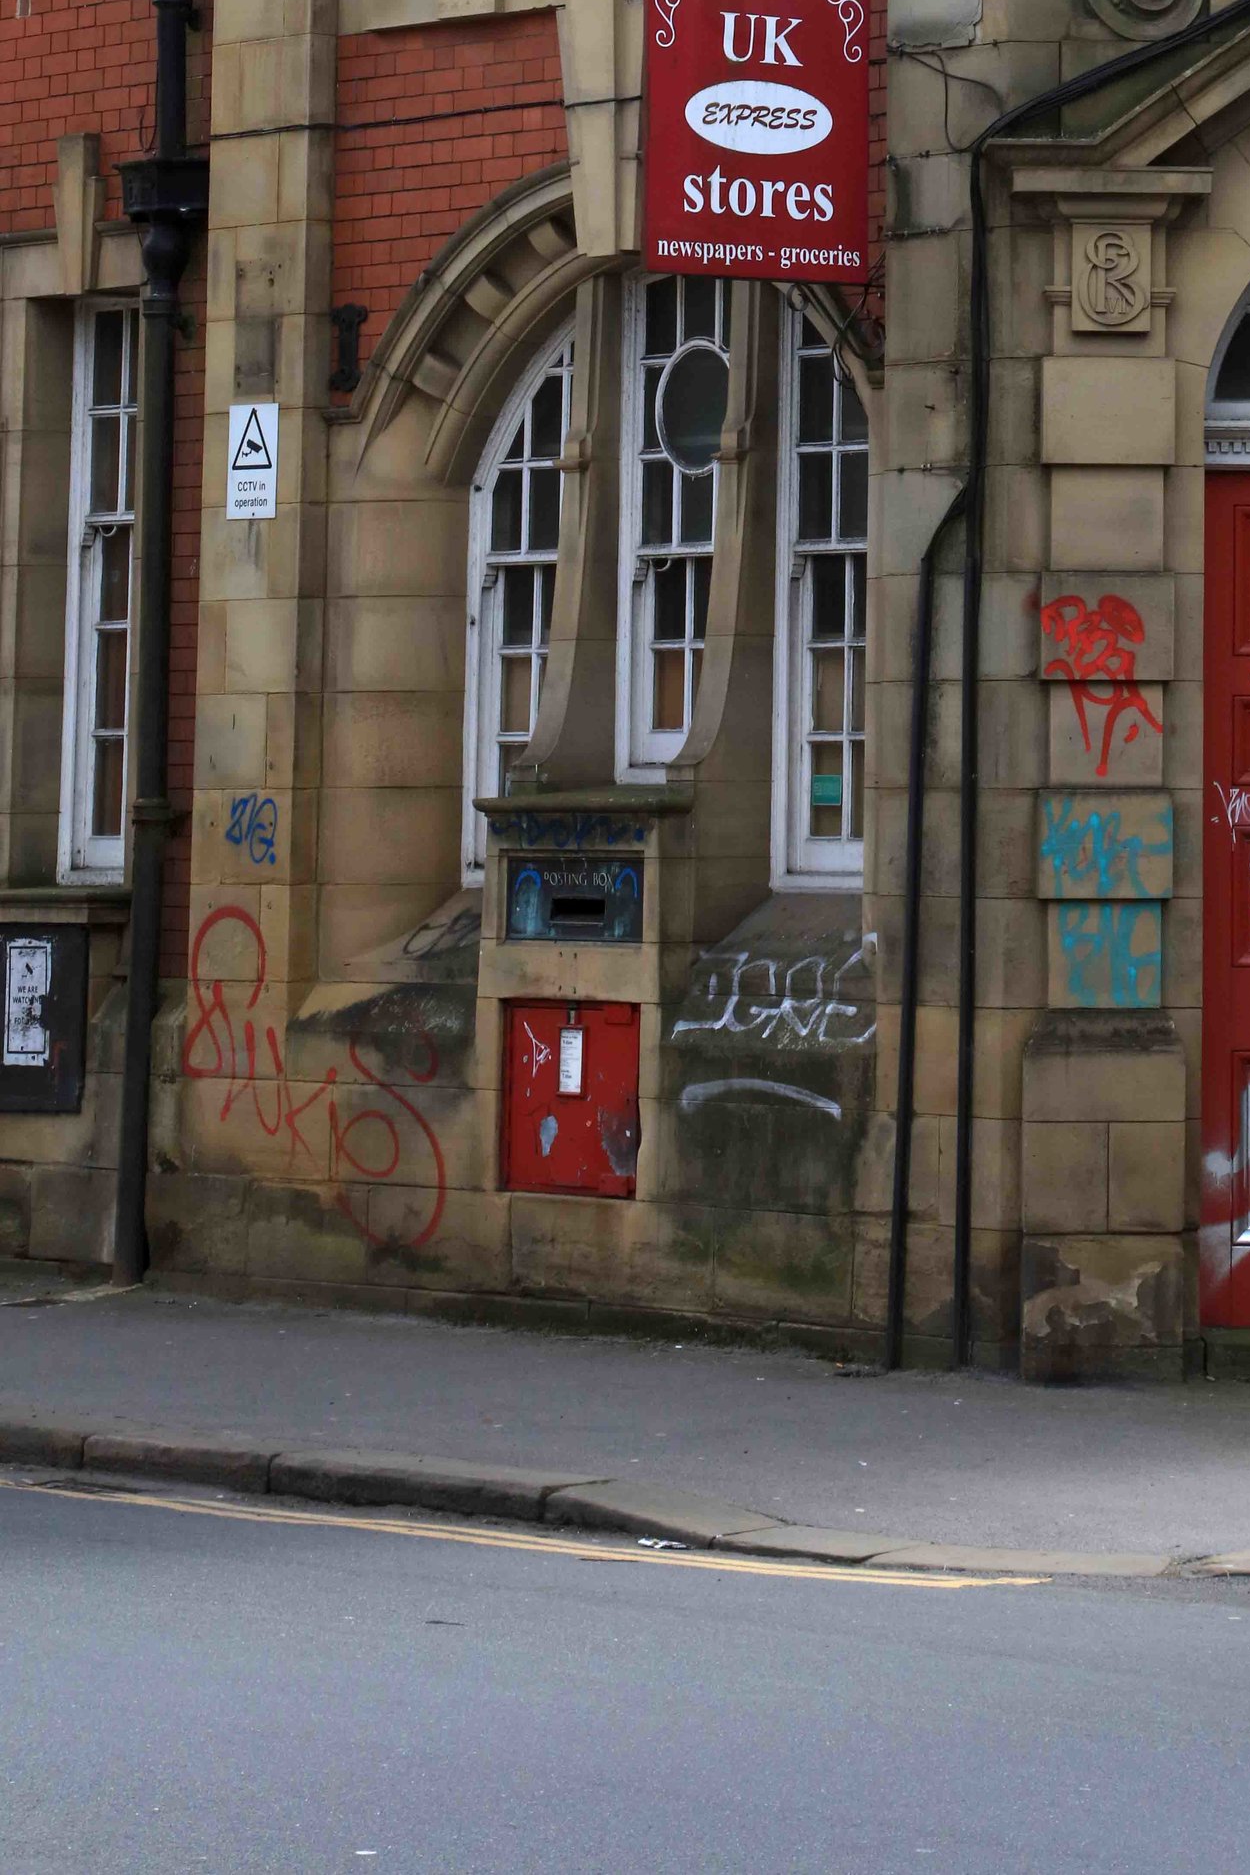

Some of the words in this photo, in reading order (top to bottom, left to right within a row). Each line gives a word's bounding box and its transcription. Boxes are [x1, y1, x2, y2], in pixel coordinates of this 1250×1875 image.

[720, 11, 804, 67] UK
[702, 101, 818, 130] EXPRESS
[683, 165, 835, 222] stores
[657, 239, 764, 262] newspapers
[780, 245, 861, 268] groceries
[237, 481, 258, 491] CCTV
[259, 482, 266, 490] in
[234, 497, 267, 509] operation
[17, 985, 27, 993] WE
[27, 985, 38, 993] ARE
